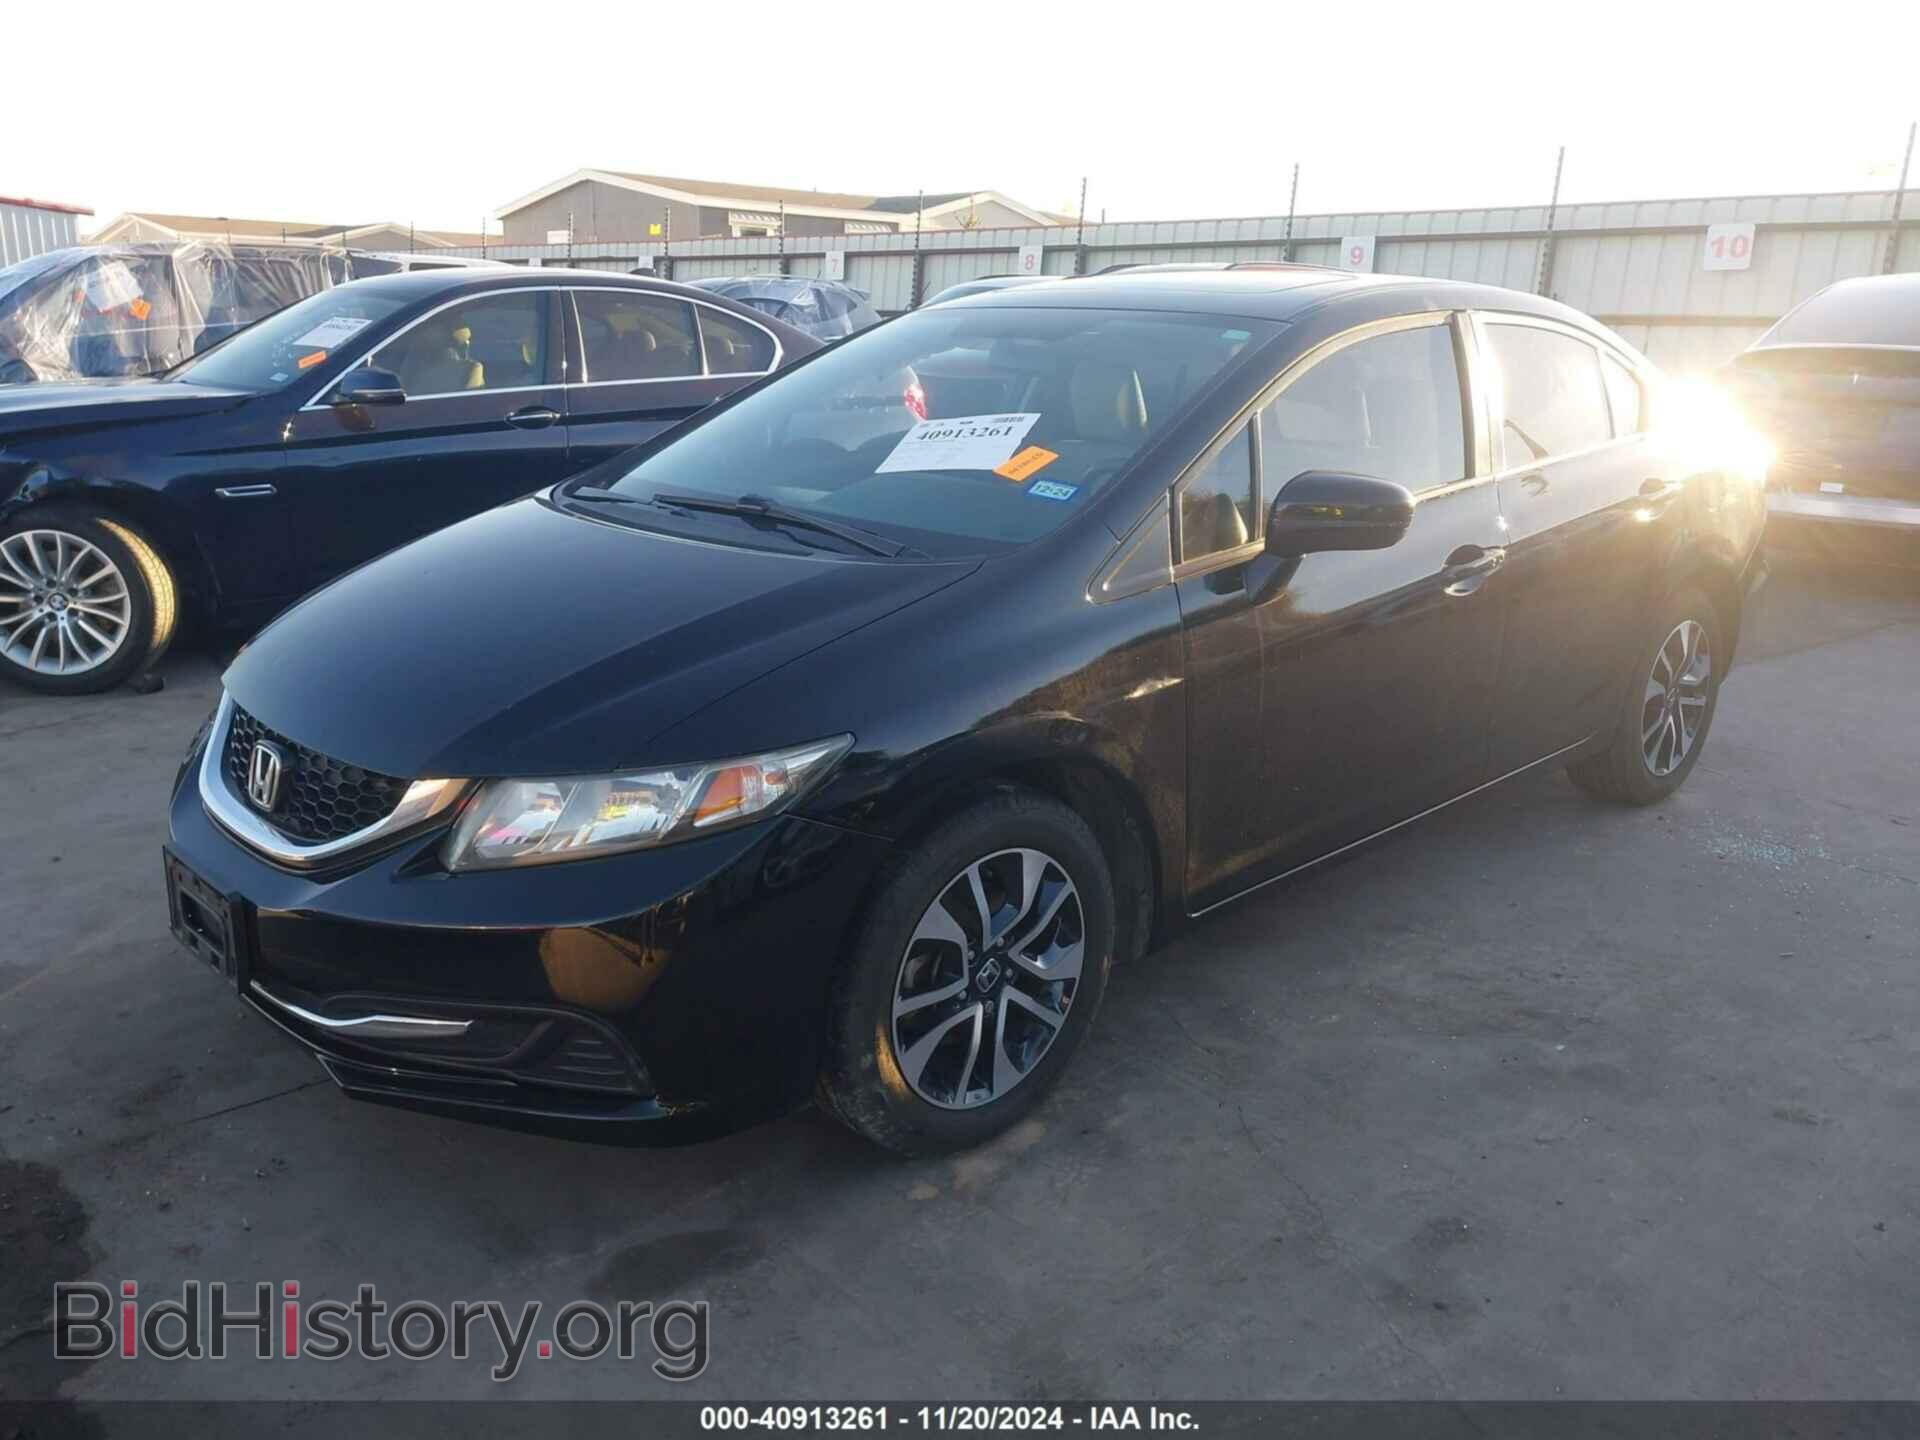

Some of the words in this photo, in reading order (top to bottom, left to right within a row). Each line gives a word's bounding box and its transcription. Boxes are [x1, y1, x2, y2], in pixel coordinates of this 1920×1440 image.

[1711, 234, 1749, 258] 10
[1024, 254, 1036, 271] 8
[1350, 246, 1361, 265] 9
[830, 258, 840, 273] 7
[915, 425, 1013, 441] 40913261
